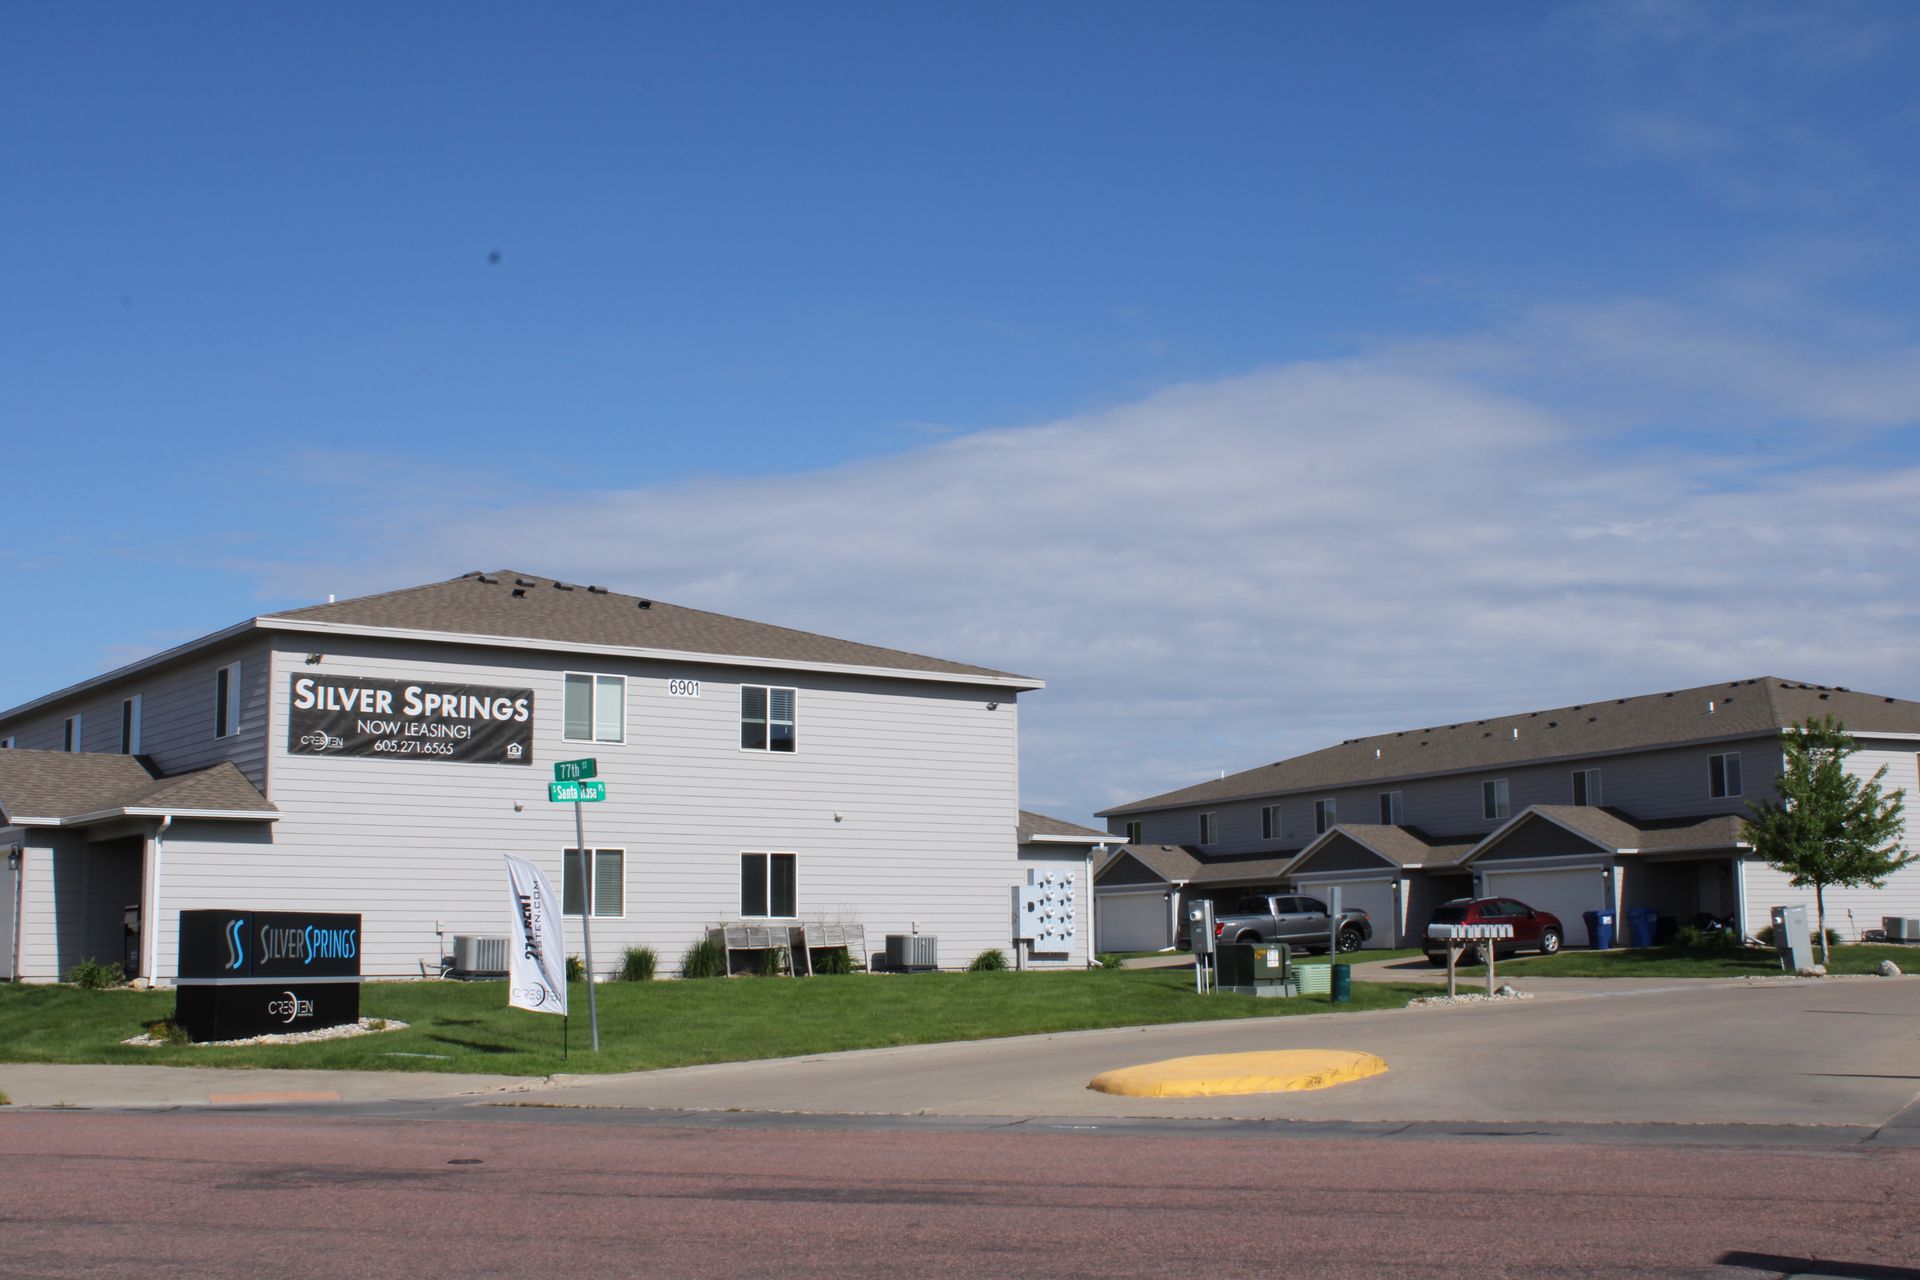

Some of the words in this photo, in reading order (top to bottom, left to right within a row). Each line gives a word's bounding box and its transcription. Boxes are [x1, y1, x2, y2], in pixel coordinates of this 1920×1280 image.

[670, 679, 699, 696] 6901
[293, 678, 394, 714] SILVER
[402, 685, 530, 722] SPRINGS
[357, 719, 402, 735] NOW
[405, 722, 471, 740] LEASING!
[374, 739, 454, 756] 605.271.6565
[560, 763, 580, 779] 77th
[557, 785, 578, 800] Santa
